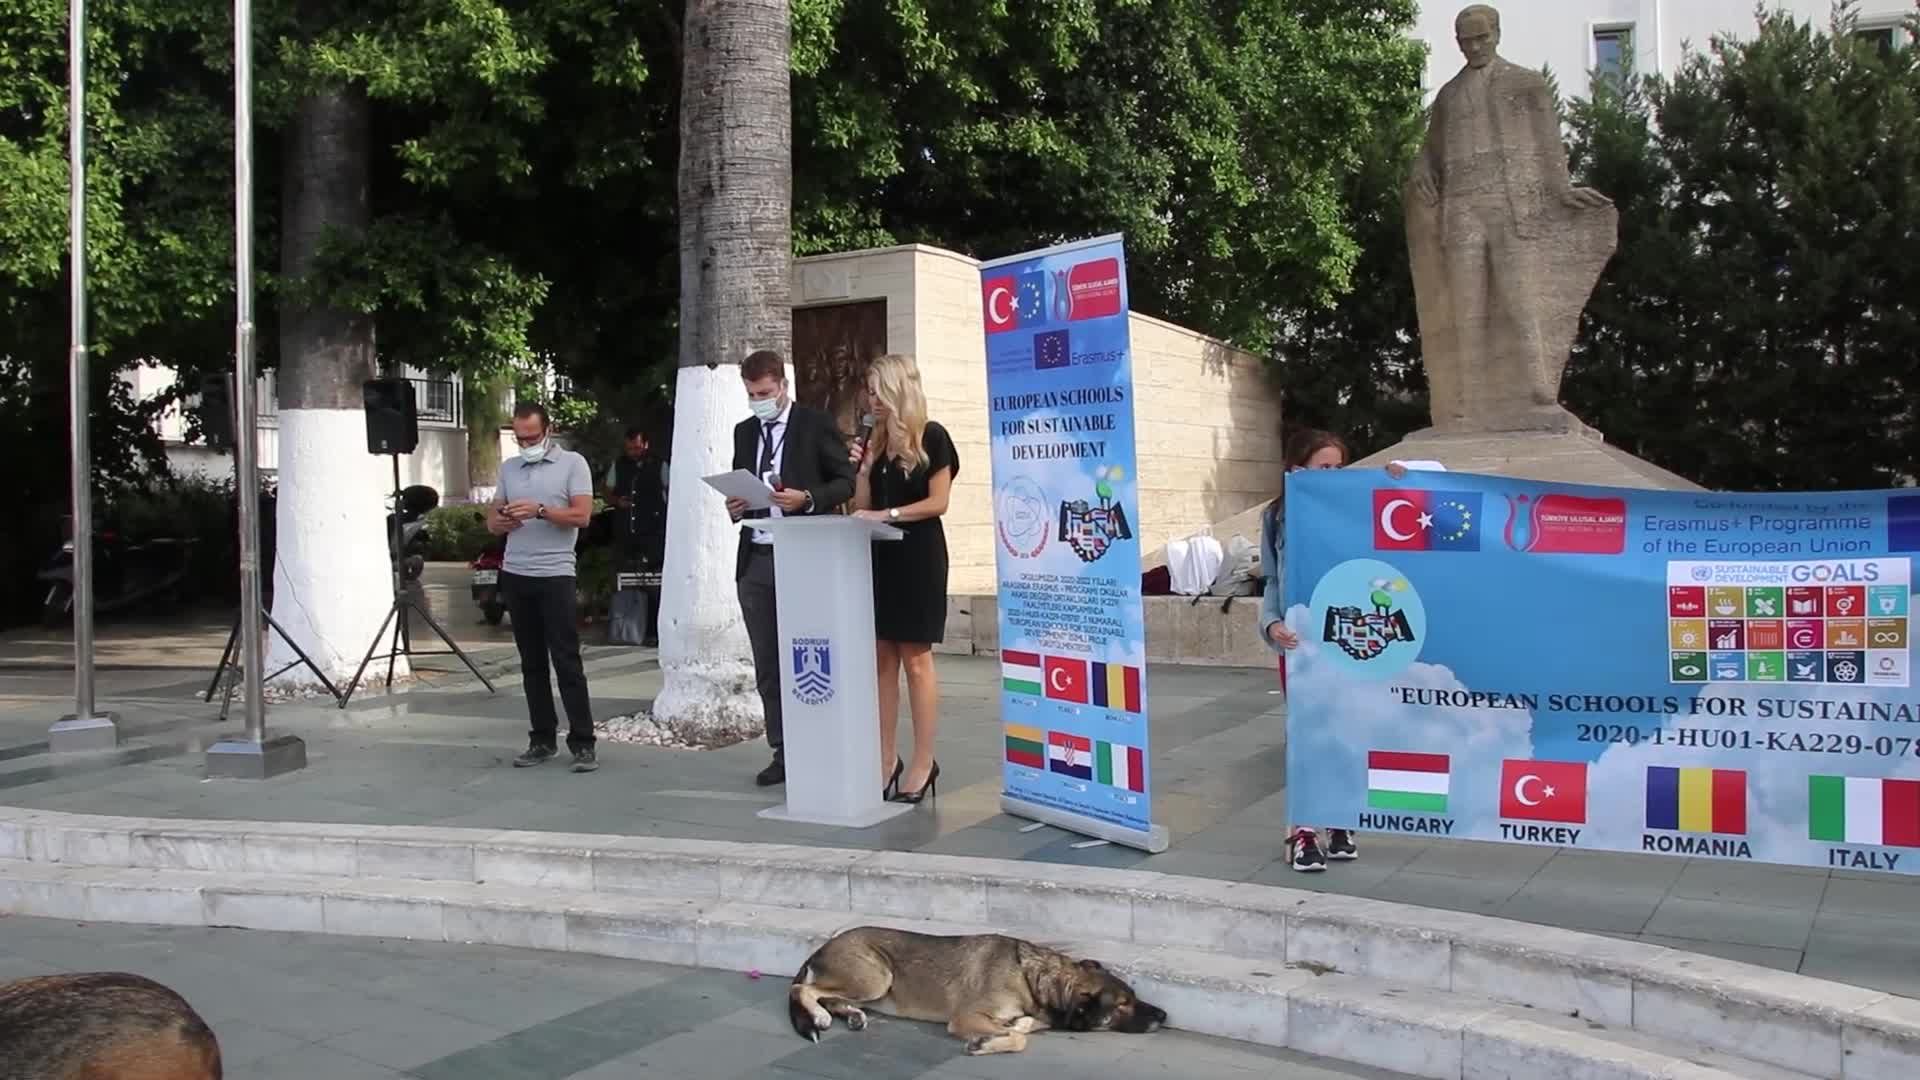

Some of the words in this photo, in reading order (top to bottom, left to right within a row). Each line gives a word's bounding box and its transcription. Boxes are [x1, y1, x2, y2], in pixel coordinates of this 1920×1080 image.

[1072, 351, 1126, 366] Erasmus+
[993, 390, 1058, 411] EUROPEAN
[1059, 386, 1124, 405] SCHOOLS
[1001, 419, 1026, 436] FOR
[1027, 414, 1116, 434] SUSTAINABLE
[1012, 441, 1106, 460] DEVELOPMENT
[1644, 515, 1743, 532] Erasmus+
[1749, 514, 1871, 534] Programme
[1643, 539, 1661, 553] of
[1667, 538, 1697, 553] the
[1705, 539, 1801, 557] European
[1810, 537, 1871, 553] Union
[1714, 564, 1789, 574] SUSTAINABLE
[1714, 574, 1788, 583] DEVELOPMENT
[1791, 562, 1879, 582] GOALS
[792, 638, 829, 646] BODRUM
[1548, 694, 1679, 714] SCHOOLS
[1689, 696, 1748, 716] FOR
[1757, 698, 1920, 724] SUSTAINA
[1359, 812, 1454, 835] HUNGARY
[1500, 823, 1581, 844] TURKEY
[1642, 833, 1752, 858] ROMANIA
[1829, 848, 1900, 870] ITALY
